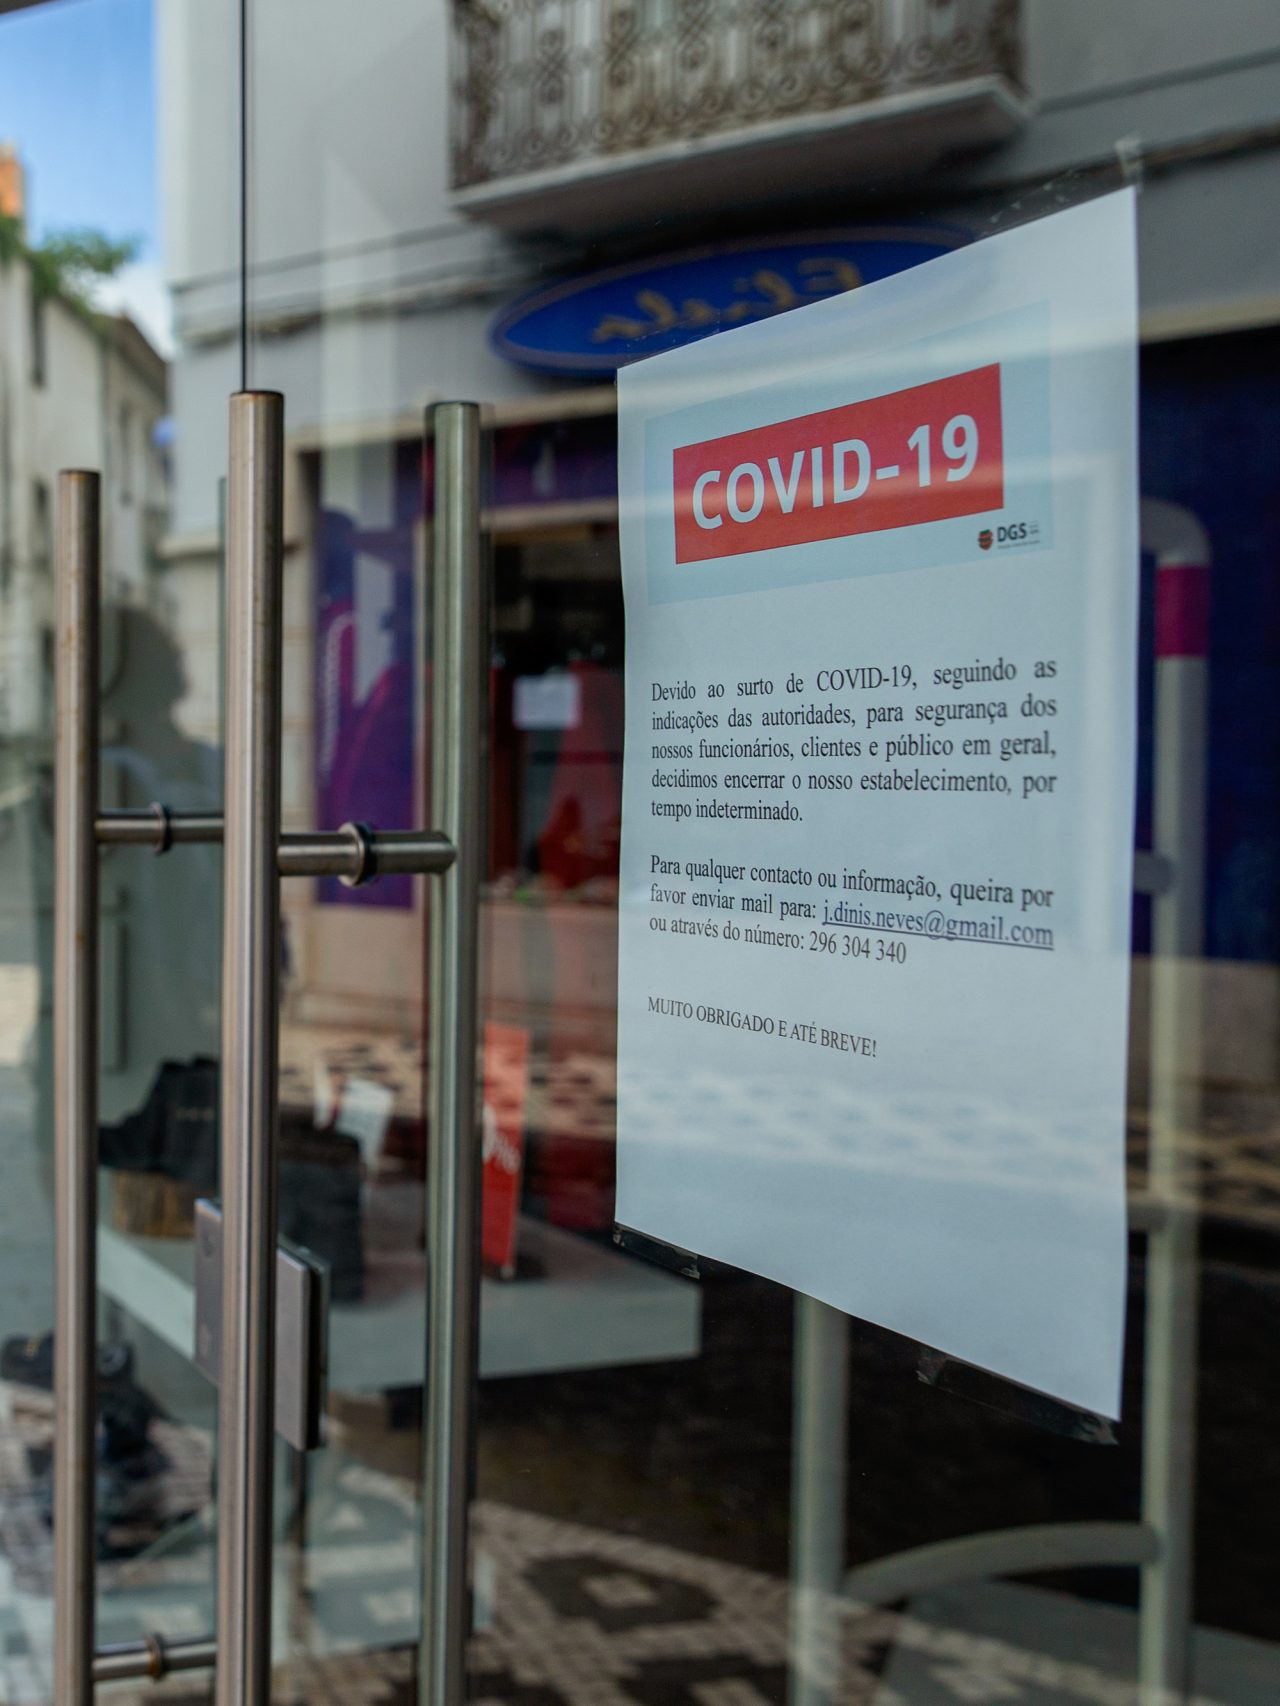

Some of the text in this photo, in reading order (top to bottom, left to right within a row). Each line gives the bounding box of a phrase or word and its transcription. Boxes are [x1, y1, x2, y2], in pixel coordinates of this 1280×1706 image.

[693, 414, 978, 529] COVID-19
[997, 522, 1027, 543] DGS
[652, 657, 1057, 702] Devido ao surto de COVID-19, seguindo as
[652, 693, 1057, 735] indicações das autoridades, para segurança dos
[652, 731, 1057, 761] nossos funcionários, clientes e público em geral,
[652, 769, 1057, 798] decidimos encerrar o nosso estabelecimento, por
[651, 801, 802, 822] tempo indeterminado.
[650, 855, 1053, 912] Para qualquer contacto ou informação, queira por
[649, 916, 906, 964] ou através do número: 296 304 340
[650, 884, 1054, 951] favor enviar mail para: j.dinis.neves@gmail.com
[648, 996, 877, 1058] MUITO OBRIGADO E ATÉ BREVE!
